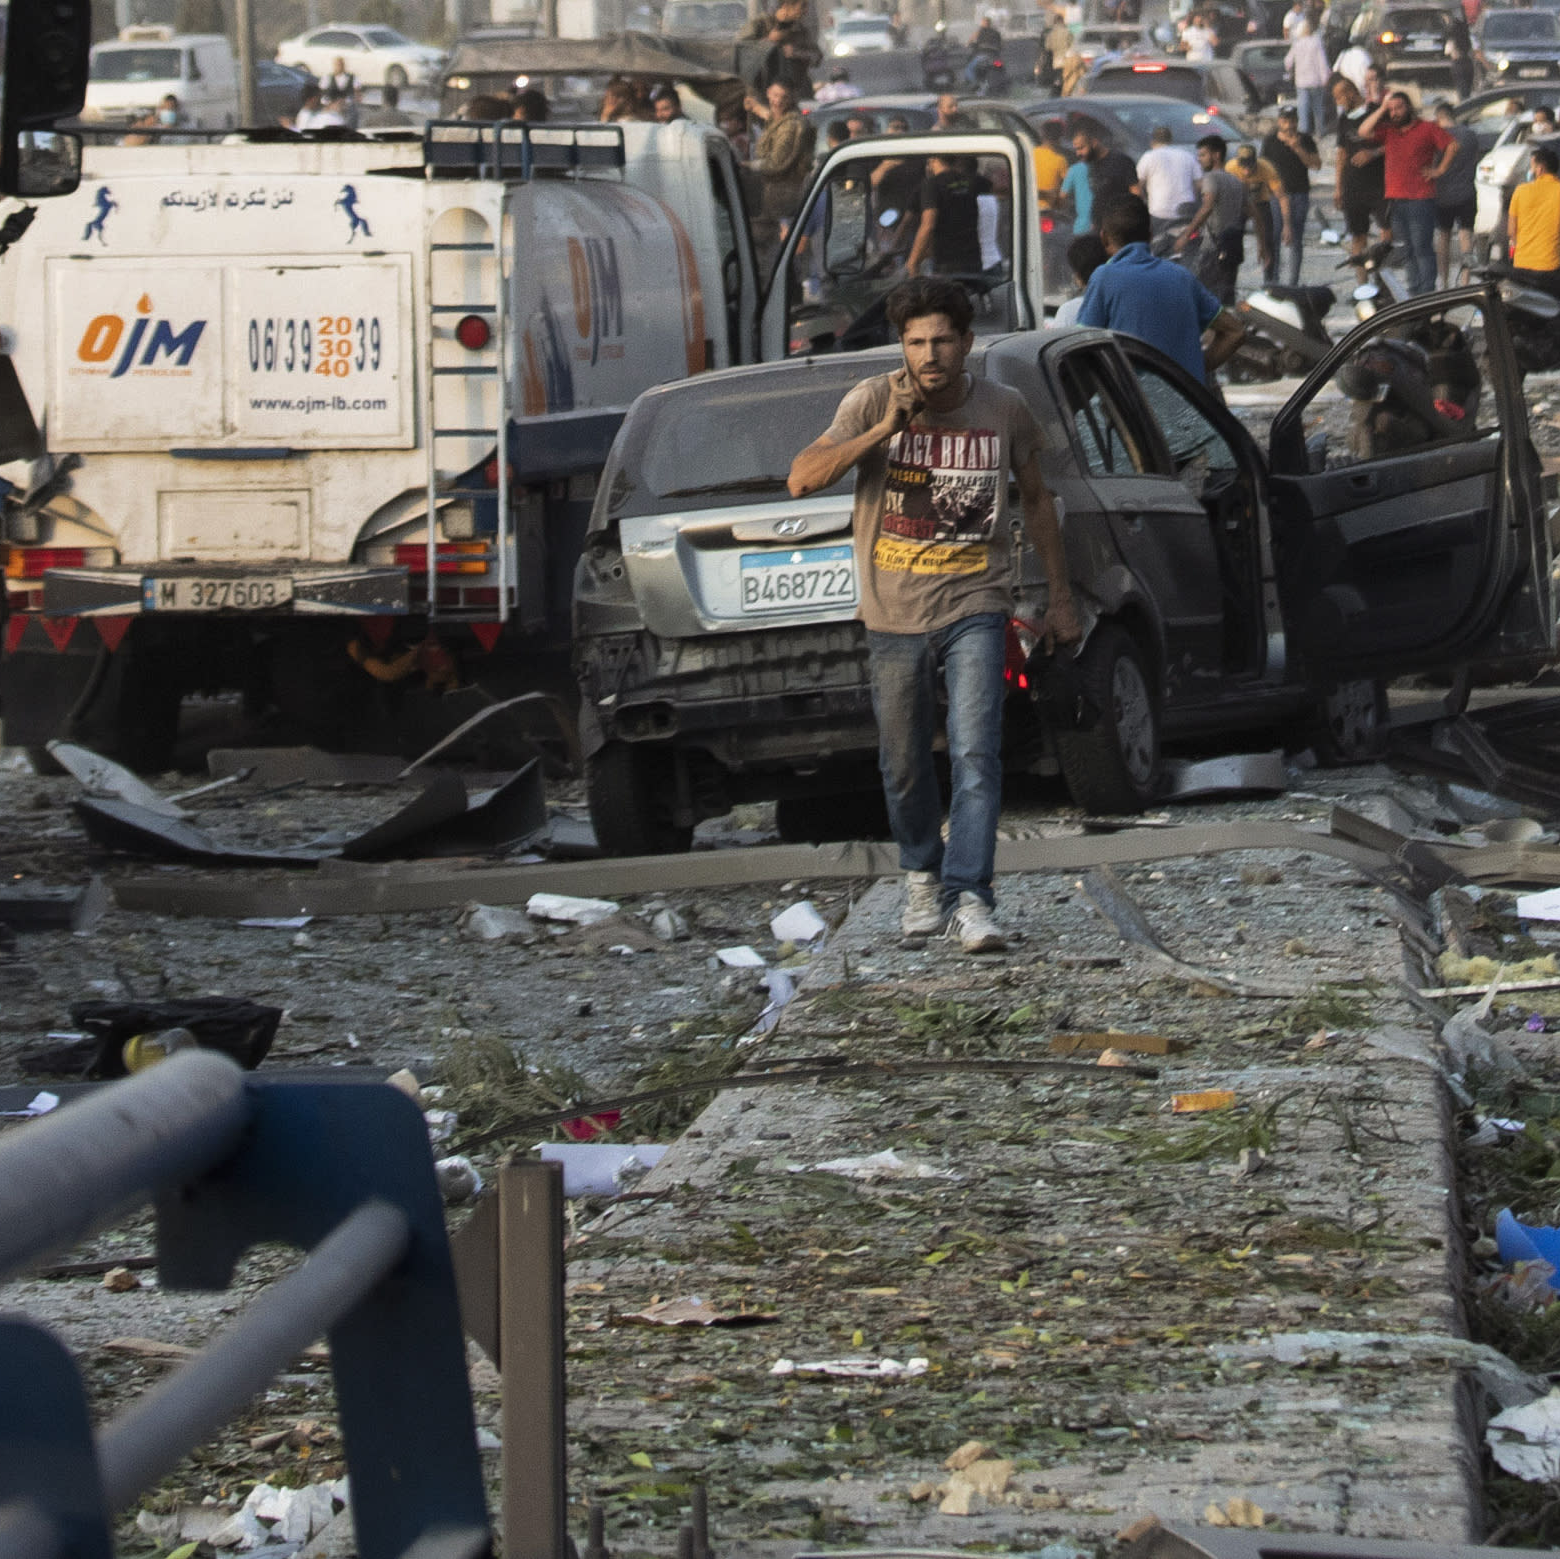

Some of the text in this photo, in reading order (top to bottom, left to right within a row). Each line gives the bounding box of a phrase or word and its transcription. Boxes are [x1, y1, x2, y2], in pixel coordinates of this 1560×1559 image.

[250, 396, 387, 413] www.ojm-lb.com
[941, 436, 1000, 469] BRAND
[161, 582, 275, 606] M 327603
[744, 567, 852, 604] B468722
